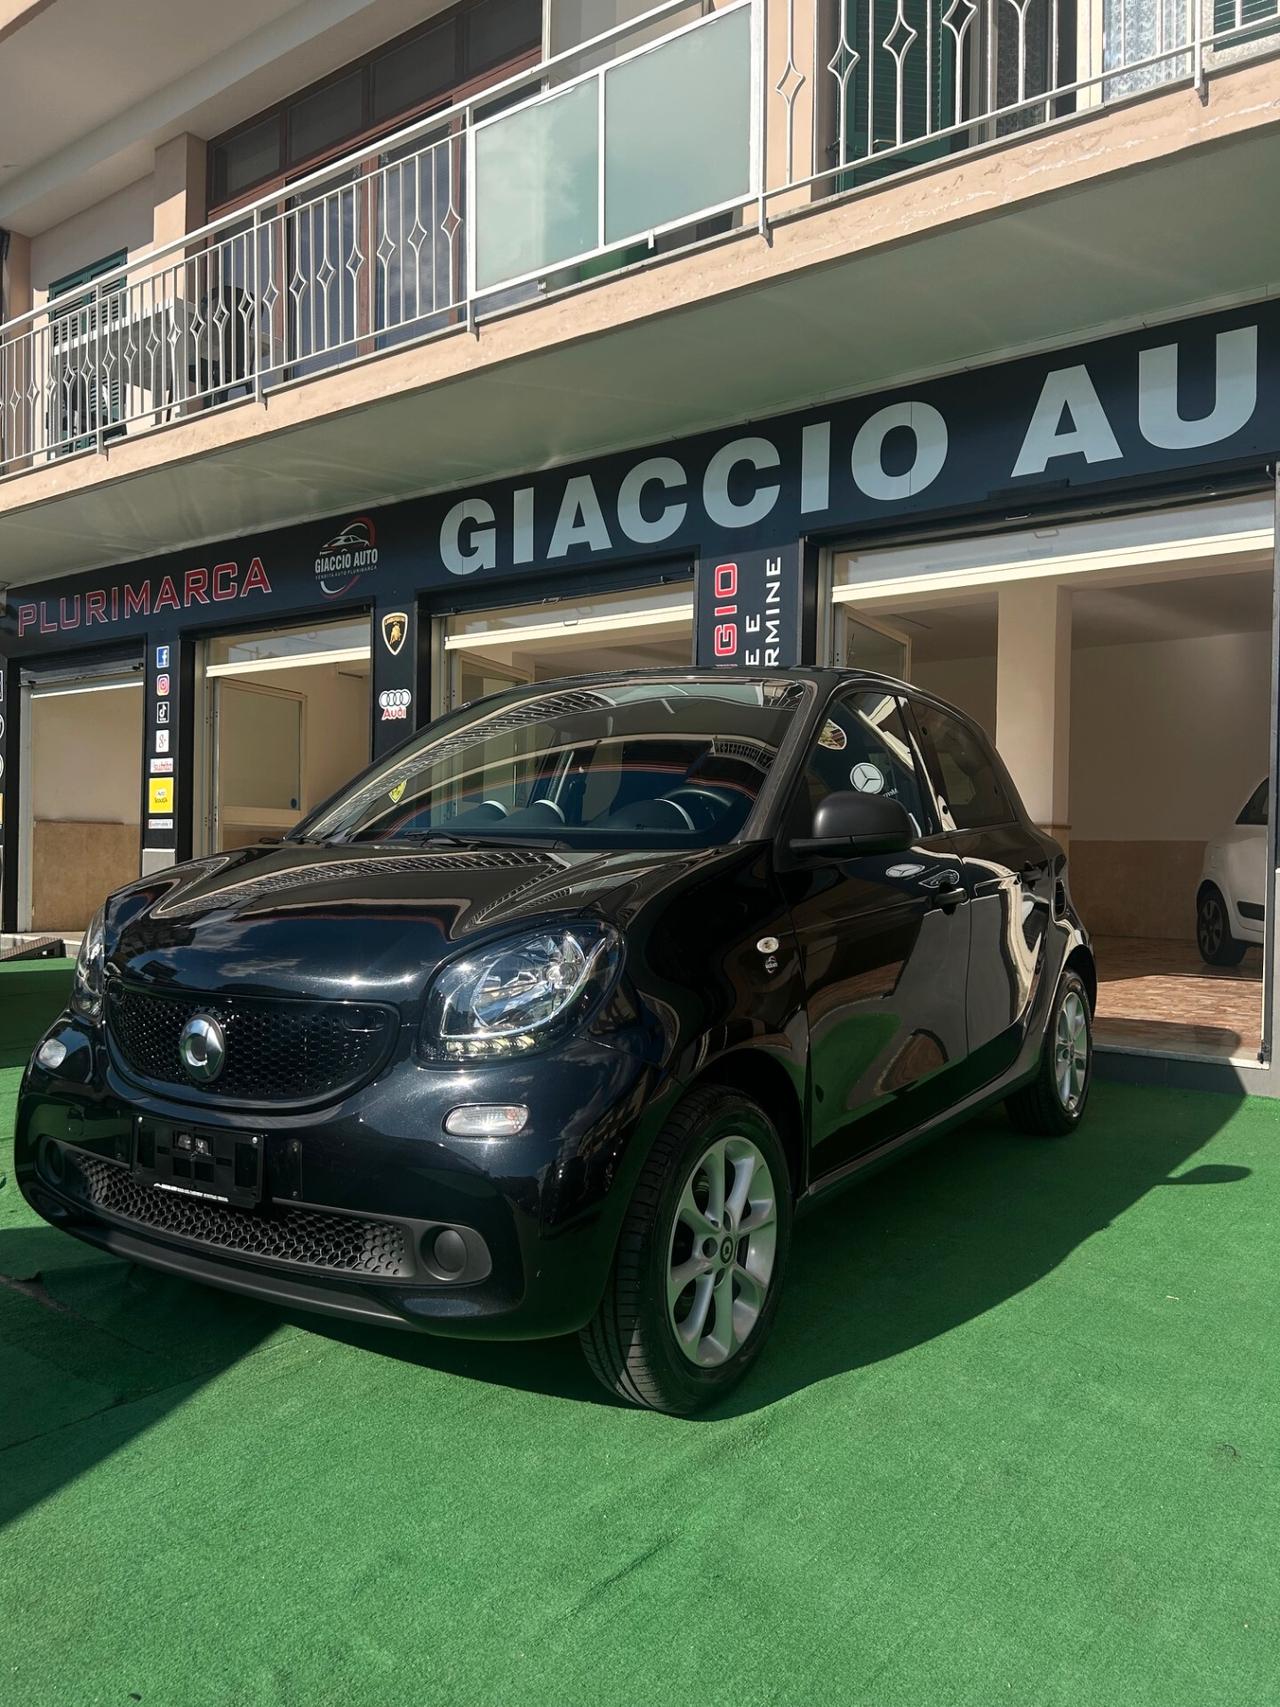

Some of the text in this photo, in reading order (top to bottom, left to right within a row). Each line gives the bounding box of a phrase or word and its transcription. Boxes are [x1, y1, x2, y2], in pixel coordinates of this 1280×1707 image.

[440, 325, 1258, 576] GIACCIO AU
[18, 557, 272, 637] PLURIMARCA
[314, 548, 378, 574] GIACCIO AUTO
[714, 563, 738, 667] GIO
[745, 613, 760, 633] E
[765, 557, 781, 667] RMINE
[382, 706, 407, 719] Audi
